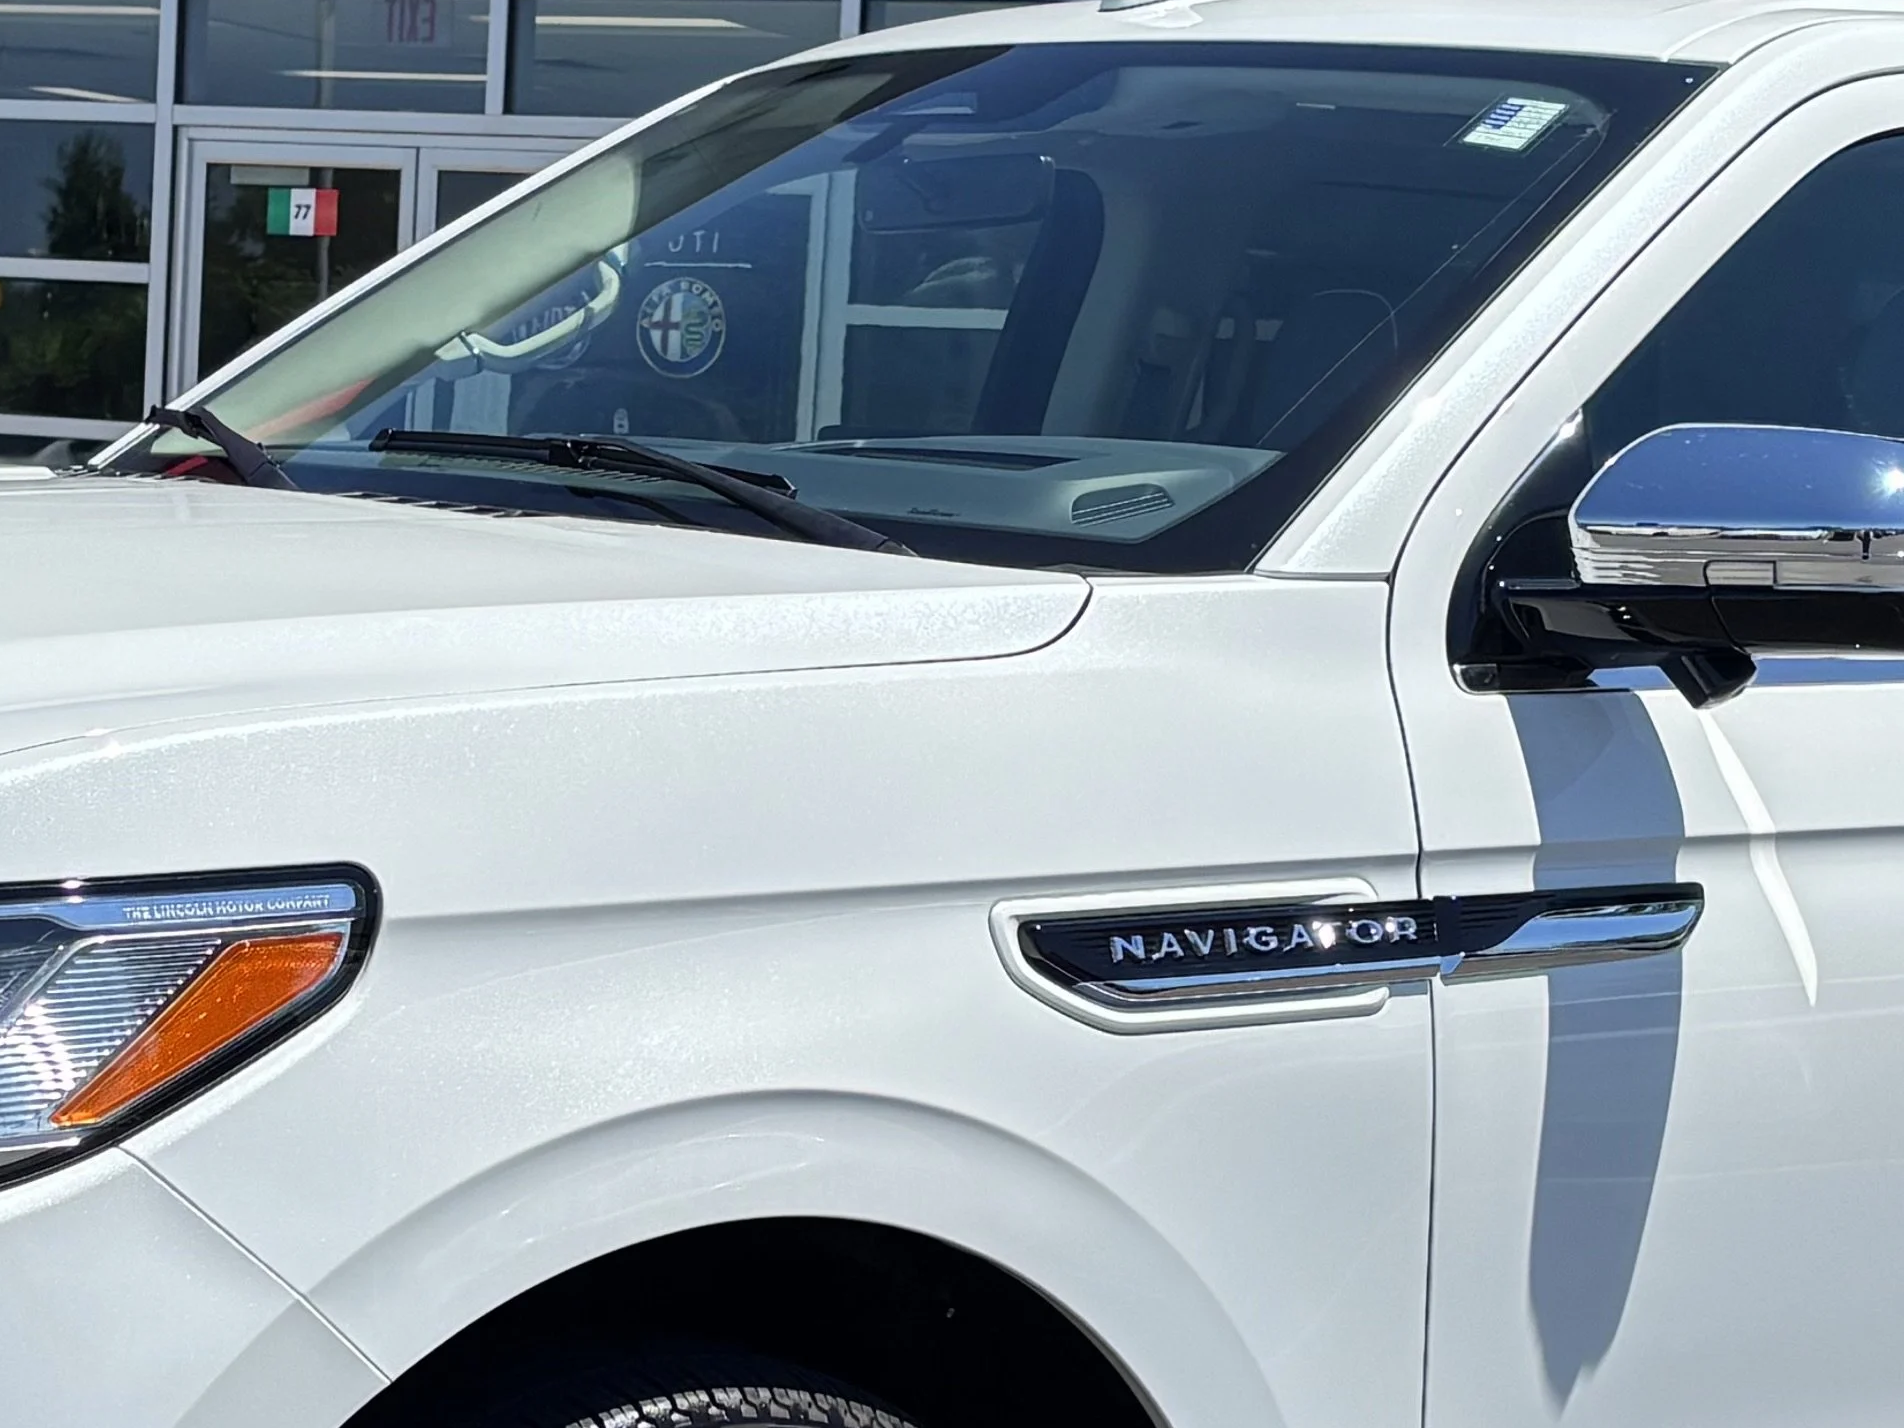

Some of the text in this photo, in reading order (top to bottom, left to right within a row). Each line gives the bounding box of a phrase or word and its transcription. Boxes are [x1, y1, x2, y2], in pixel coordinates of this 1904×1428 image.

[294, 203, 312, 221] 77
[122, 894, 331, 920] THE LINCOLN MOTOR COMPANY
[1109, 915, 1418, 963] NAVIGATOR
